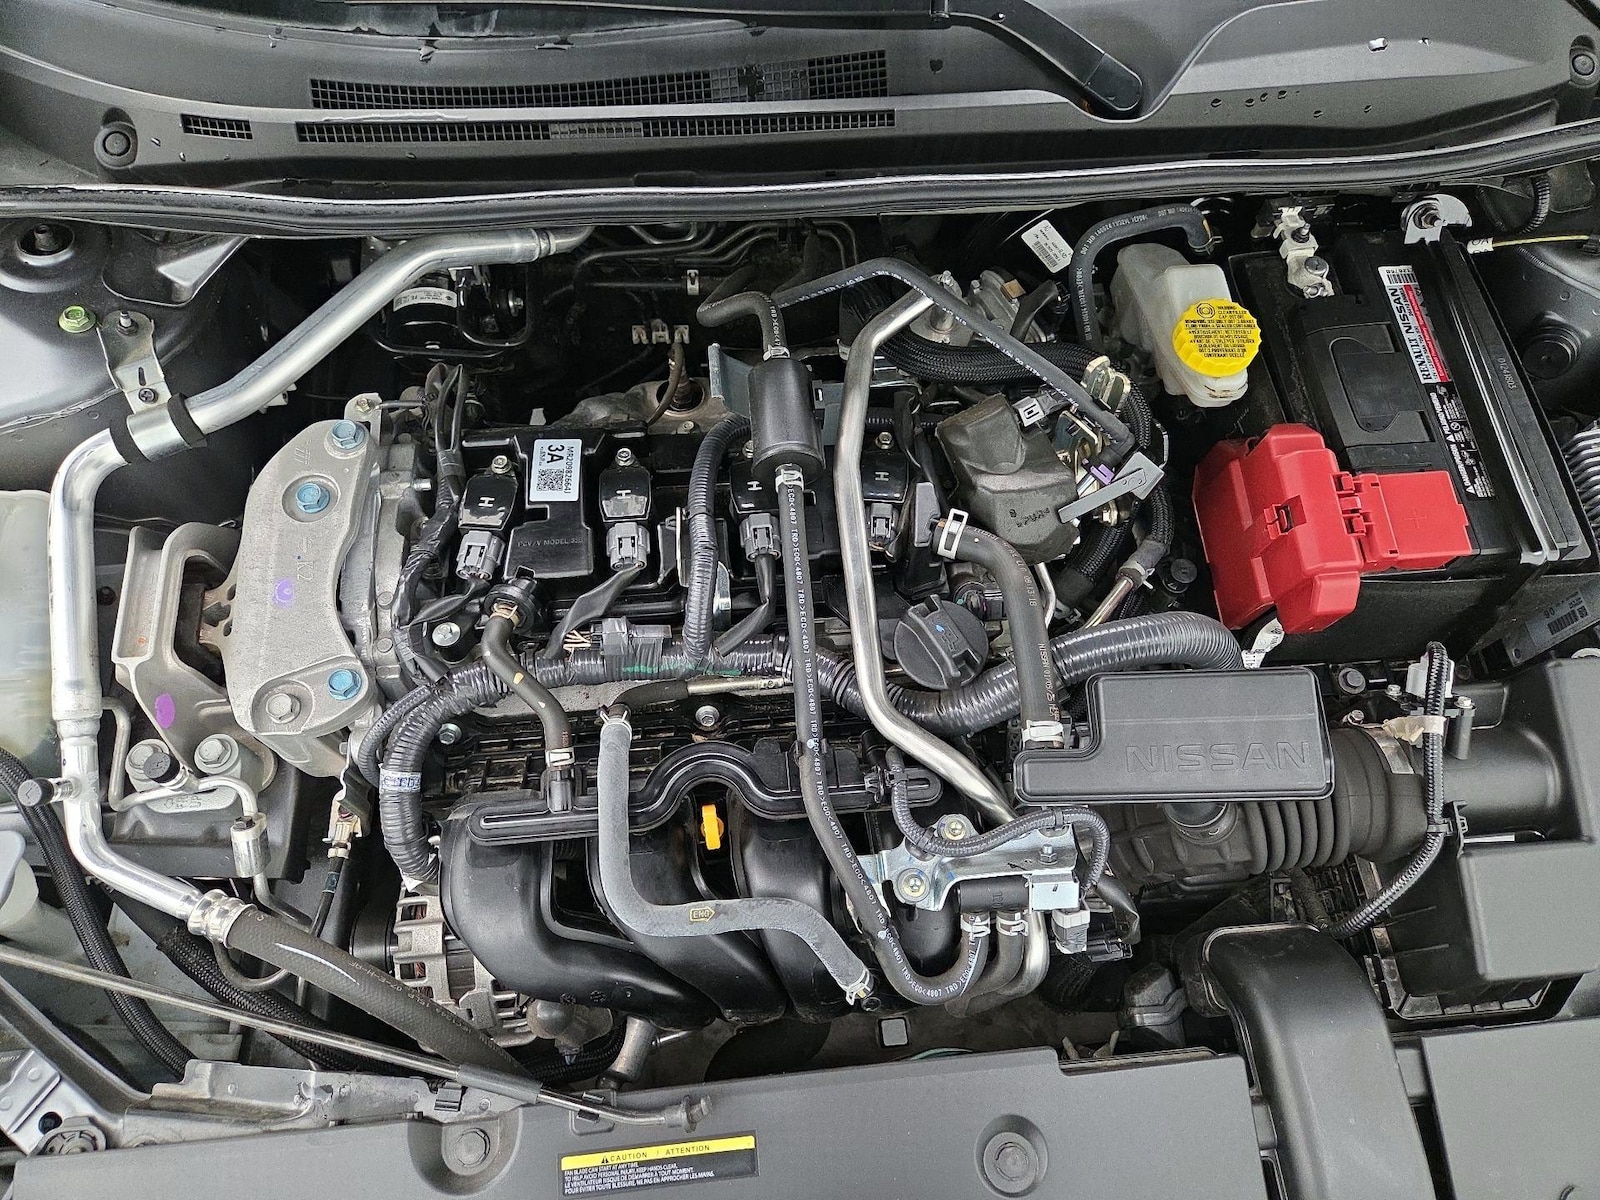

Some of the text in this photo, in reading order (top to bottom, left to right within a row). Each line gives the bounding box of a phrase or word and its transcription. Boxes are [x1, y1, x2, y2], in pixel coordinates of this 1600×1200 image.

[1388, 287, 1414, 333] NISSAN
[1407, 336, 1432, 380] RENAULT
[546, 444, 565, 464] 3A
[1126, 742, 1310, 773] NISSAN
[610, 1152, 647, 1162] CAUTION
[665, 1145, 710, 1156] ATTENTION
[572, 1179, 602, 1187] VENTILATEUR
